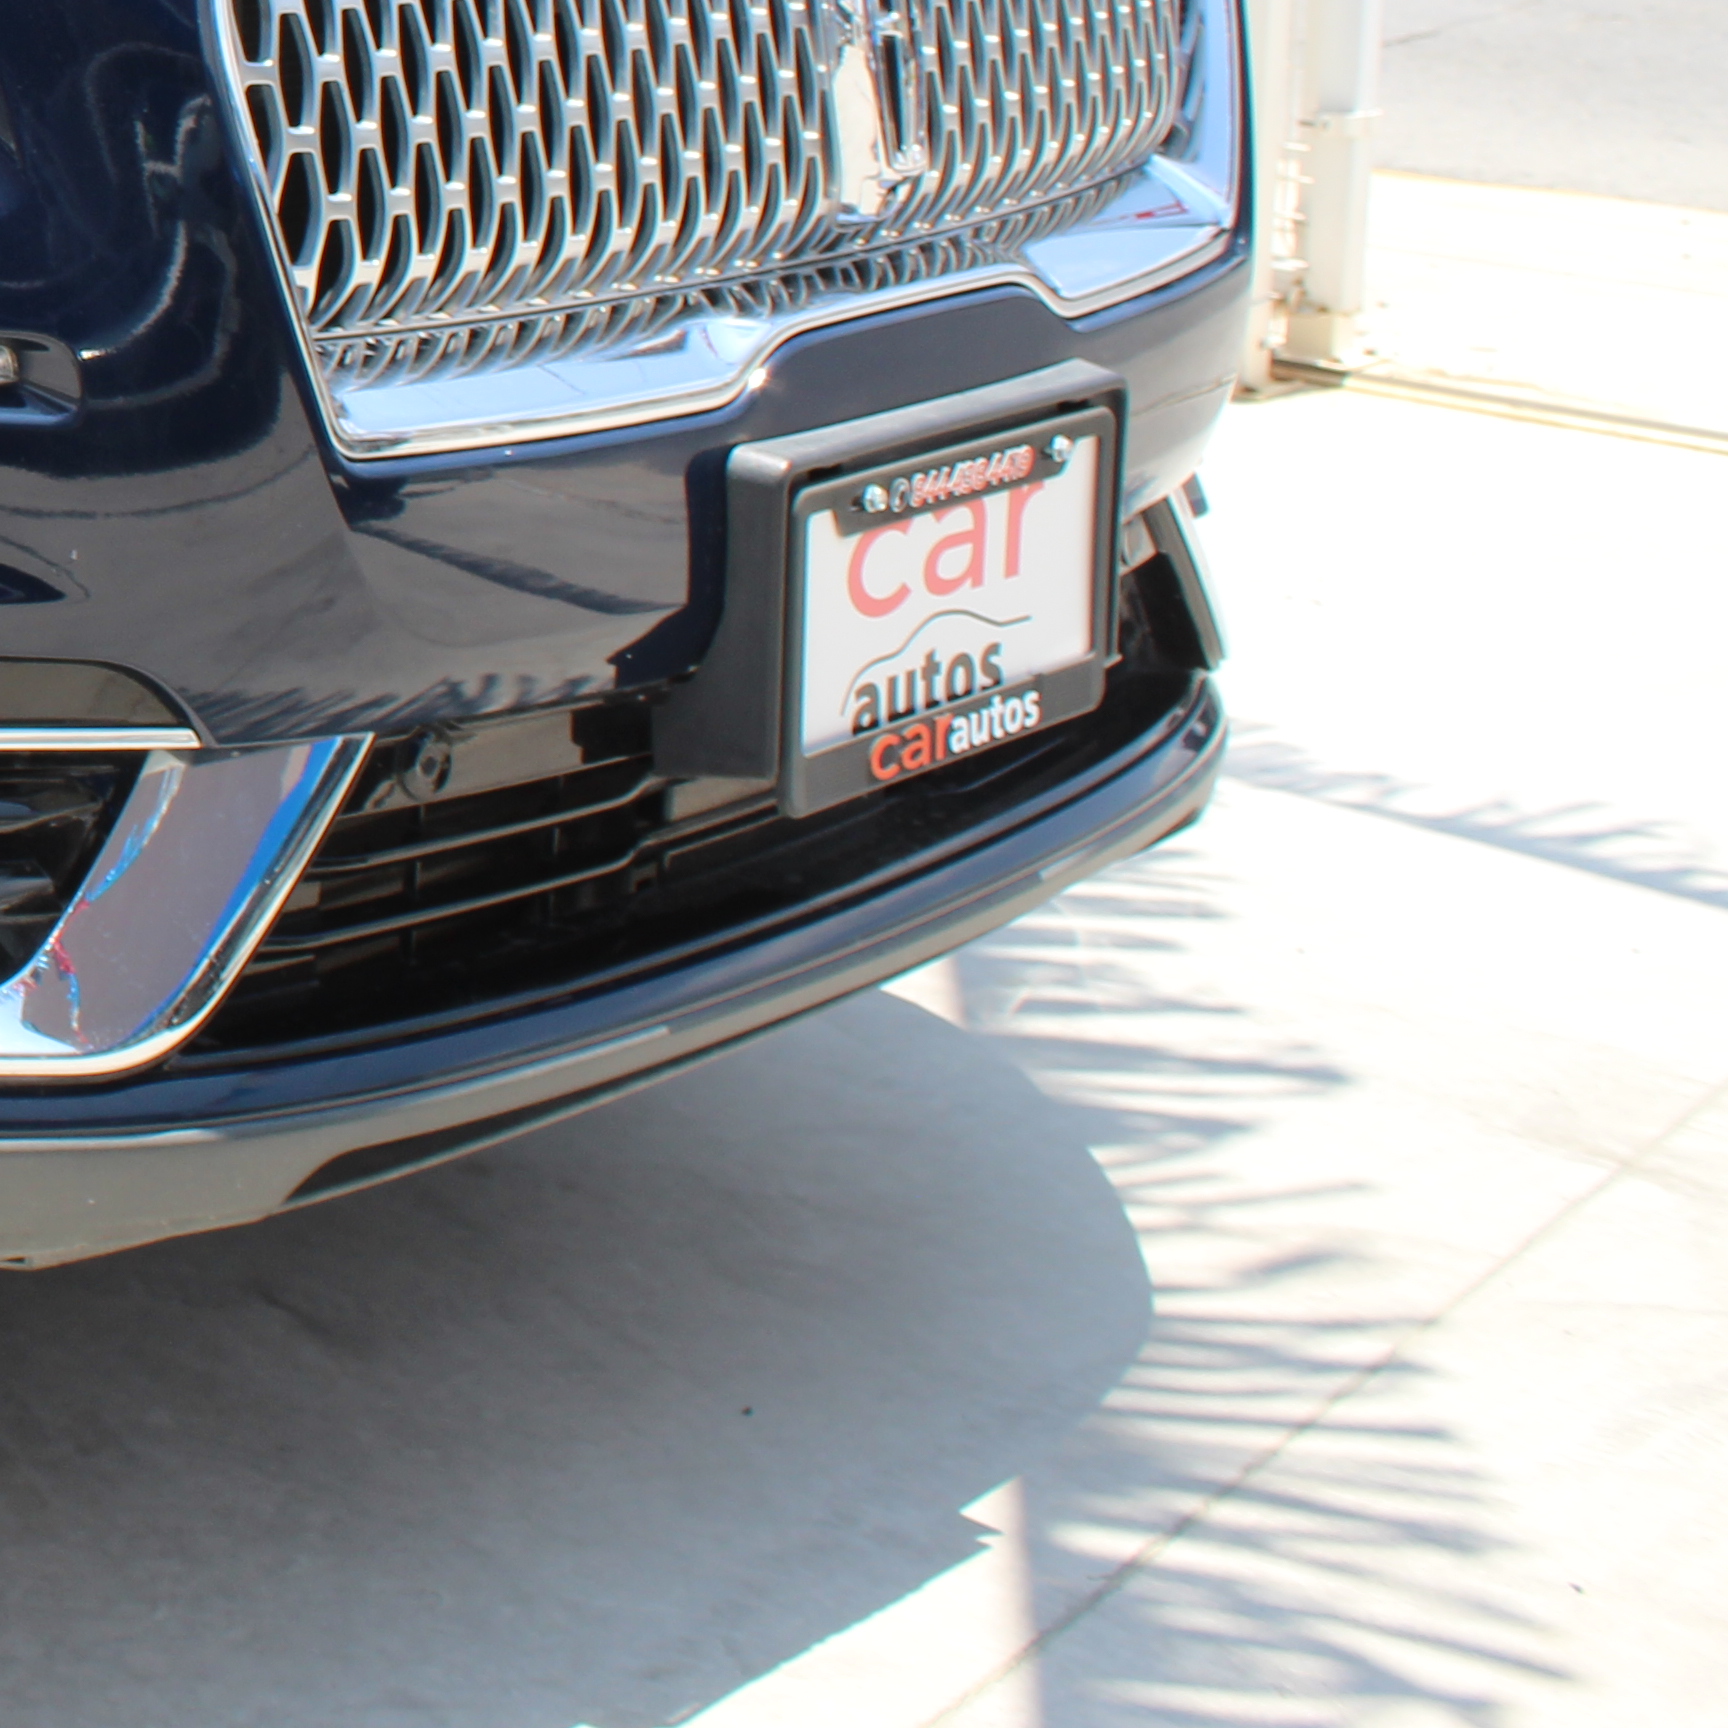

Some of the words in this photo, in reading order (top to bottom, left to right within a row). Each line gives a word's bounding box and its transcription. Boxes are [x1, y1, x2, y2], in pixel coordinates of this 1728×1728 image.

[847, 478, 1047, 619] car
[851, 641, 1004, 737] autos
[870, 689, 1041, 781] carautos
